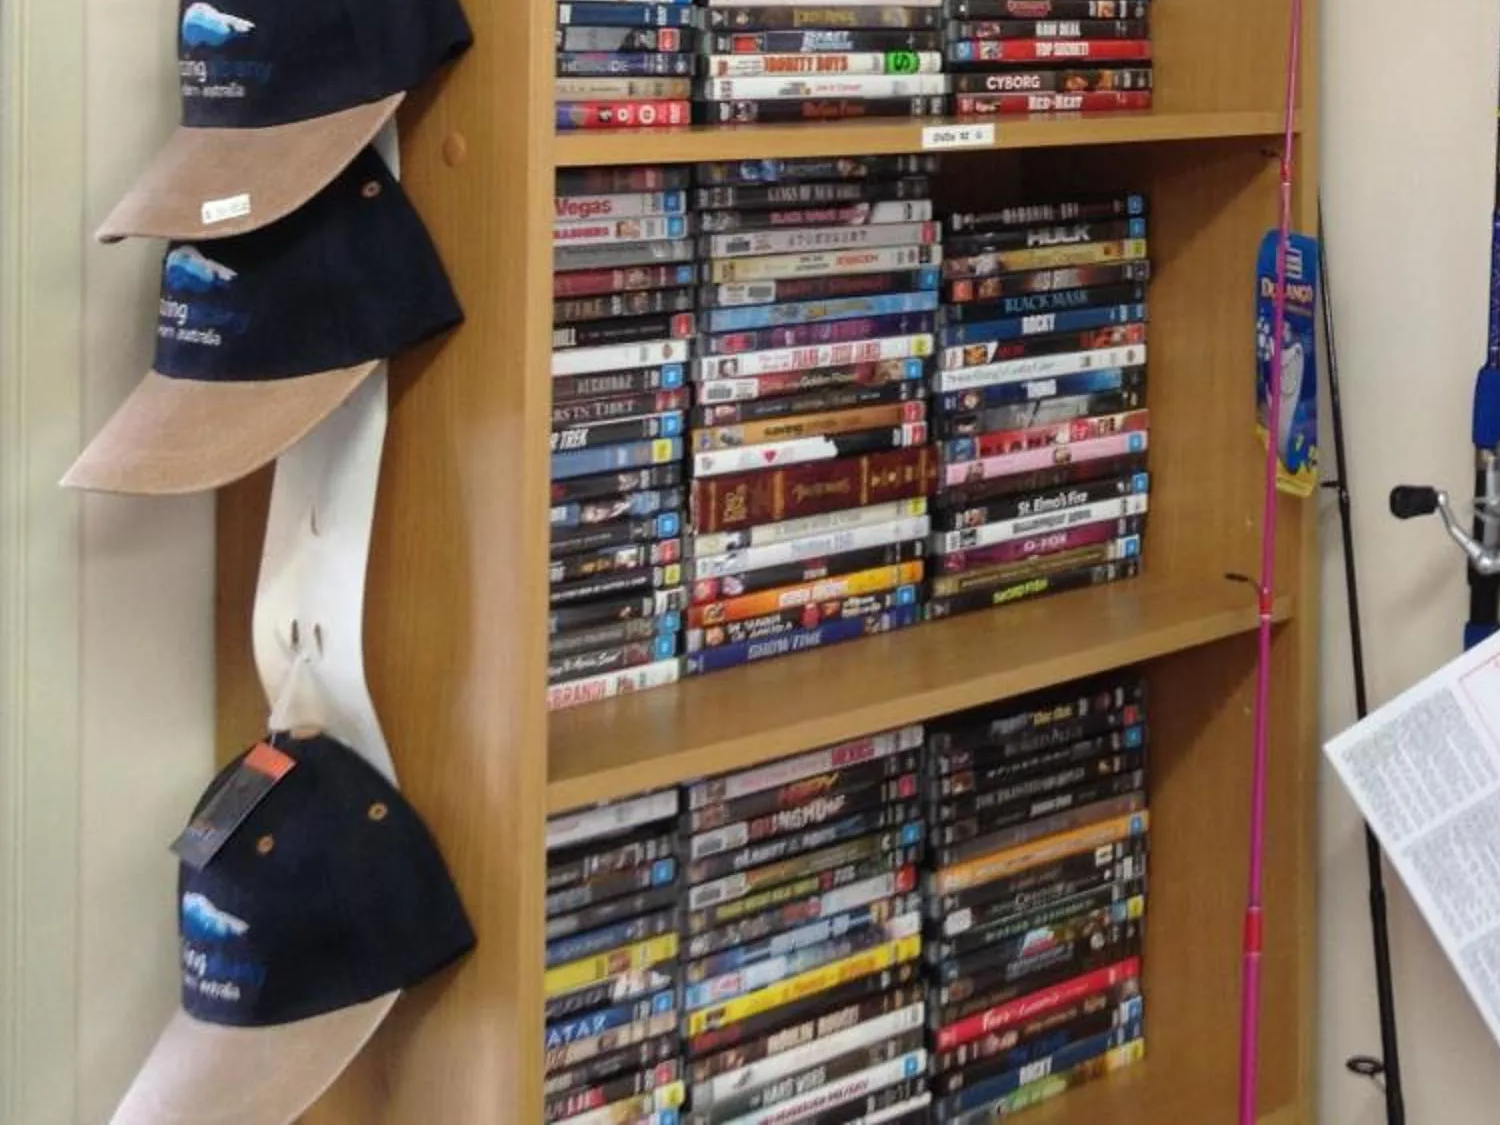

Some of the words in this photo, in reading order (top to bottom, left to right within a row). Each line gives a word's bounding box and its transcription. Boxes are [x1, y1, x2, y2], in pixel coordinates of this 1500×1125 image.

[986, 75, 1040, 91] CYBORG
[554, 198, 612, 217] Vegas
[1027, 226, 1090, 246] HULK
[1005, 293, 1051, 313] BLACK
[1022, 313, 1056, 334] ROCKY
[547, 1014, 607, 1051] ATAR
